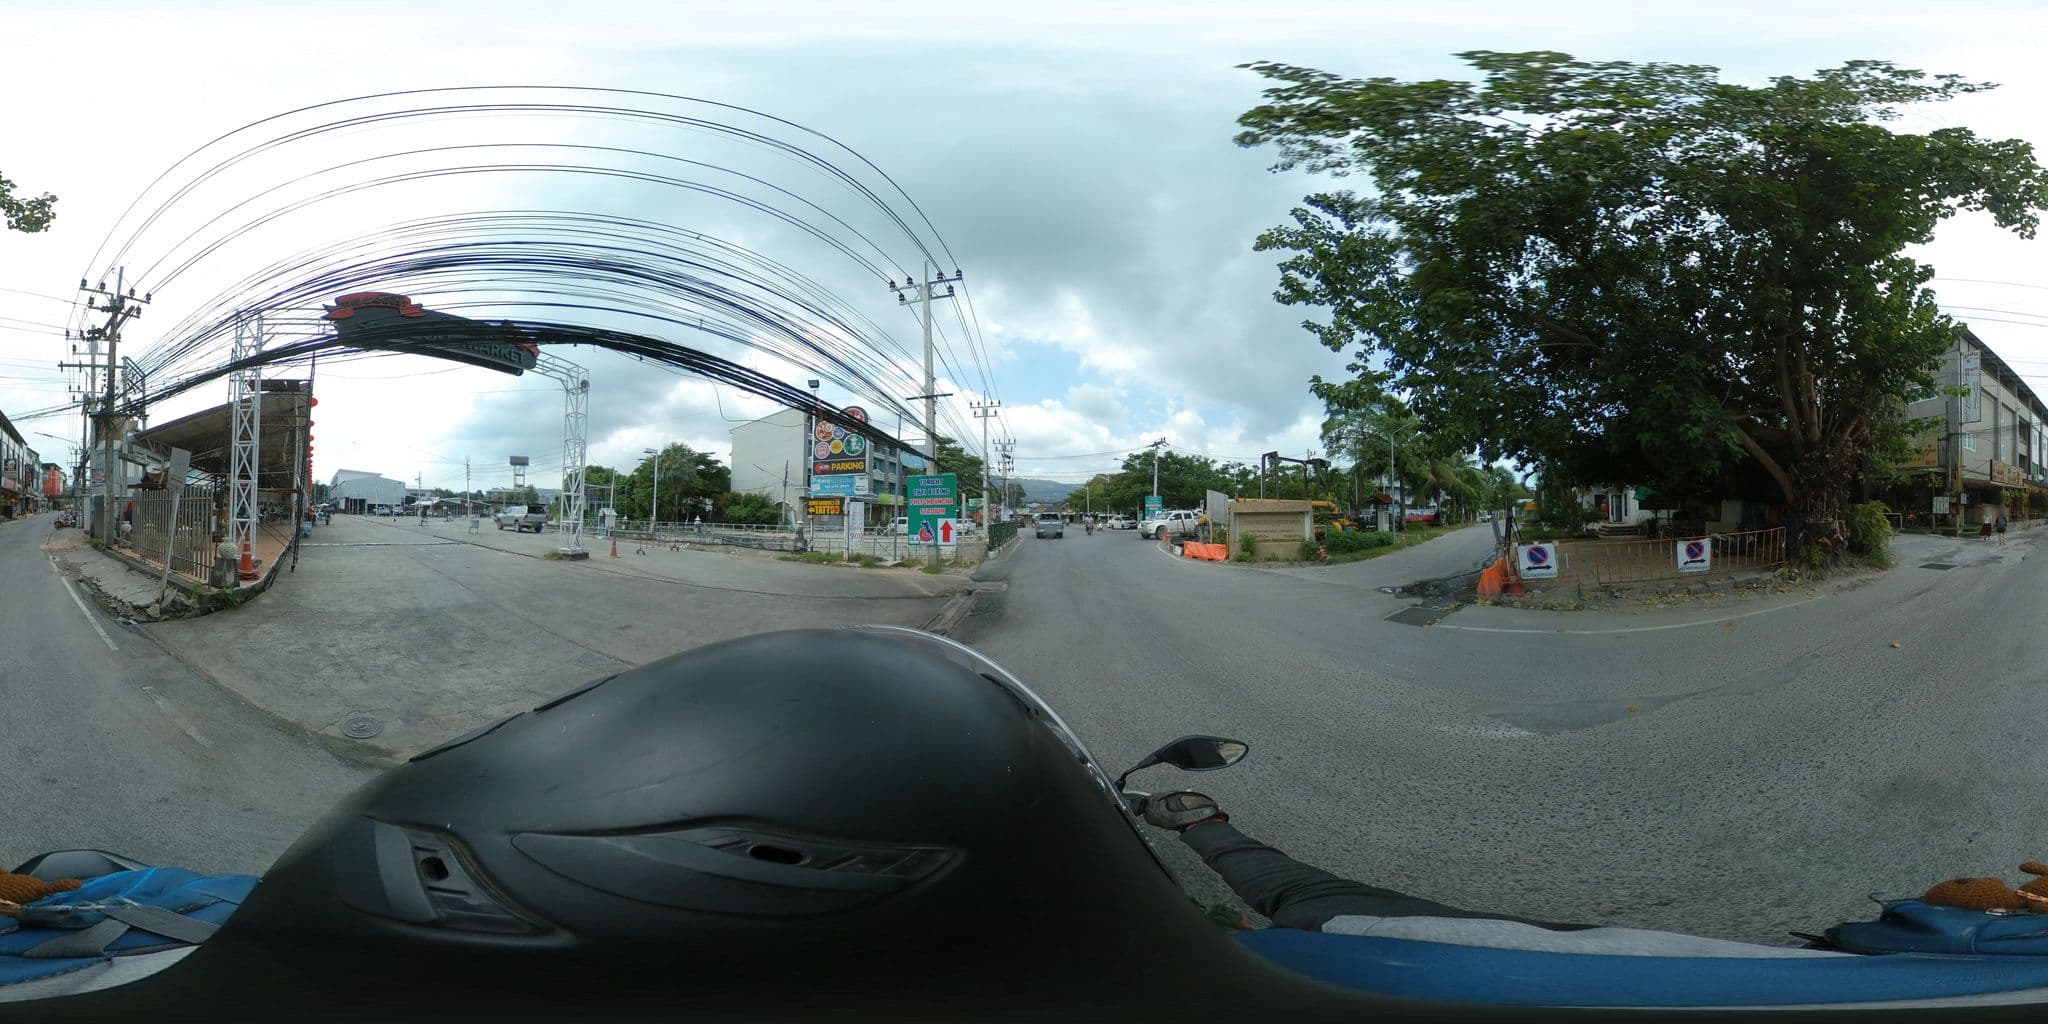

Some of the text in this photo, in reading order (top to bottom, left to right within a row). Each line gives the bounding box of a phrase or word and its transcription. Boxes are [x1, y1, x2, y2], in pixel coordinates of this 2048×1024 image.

[464, 340, 524, 365] MARKET
[831, 461, 864, 471] PARKING
[919, 478, 943, 486] TONIGHT
[815, 505, 840, 515] TATTOO
